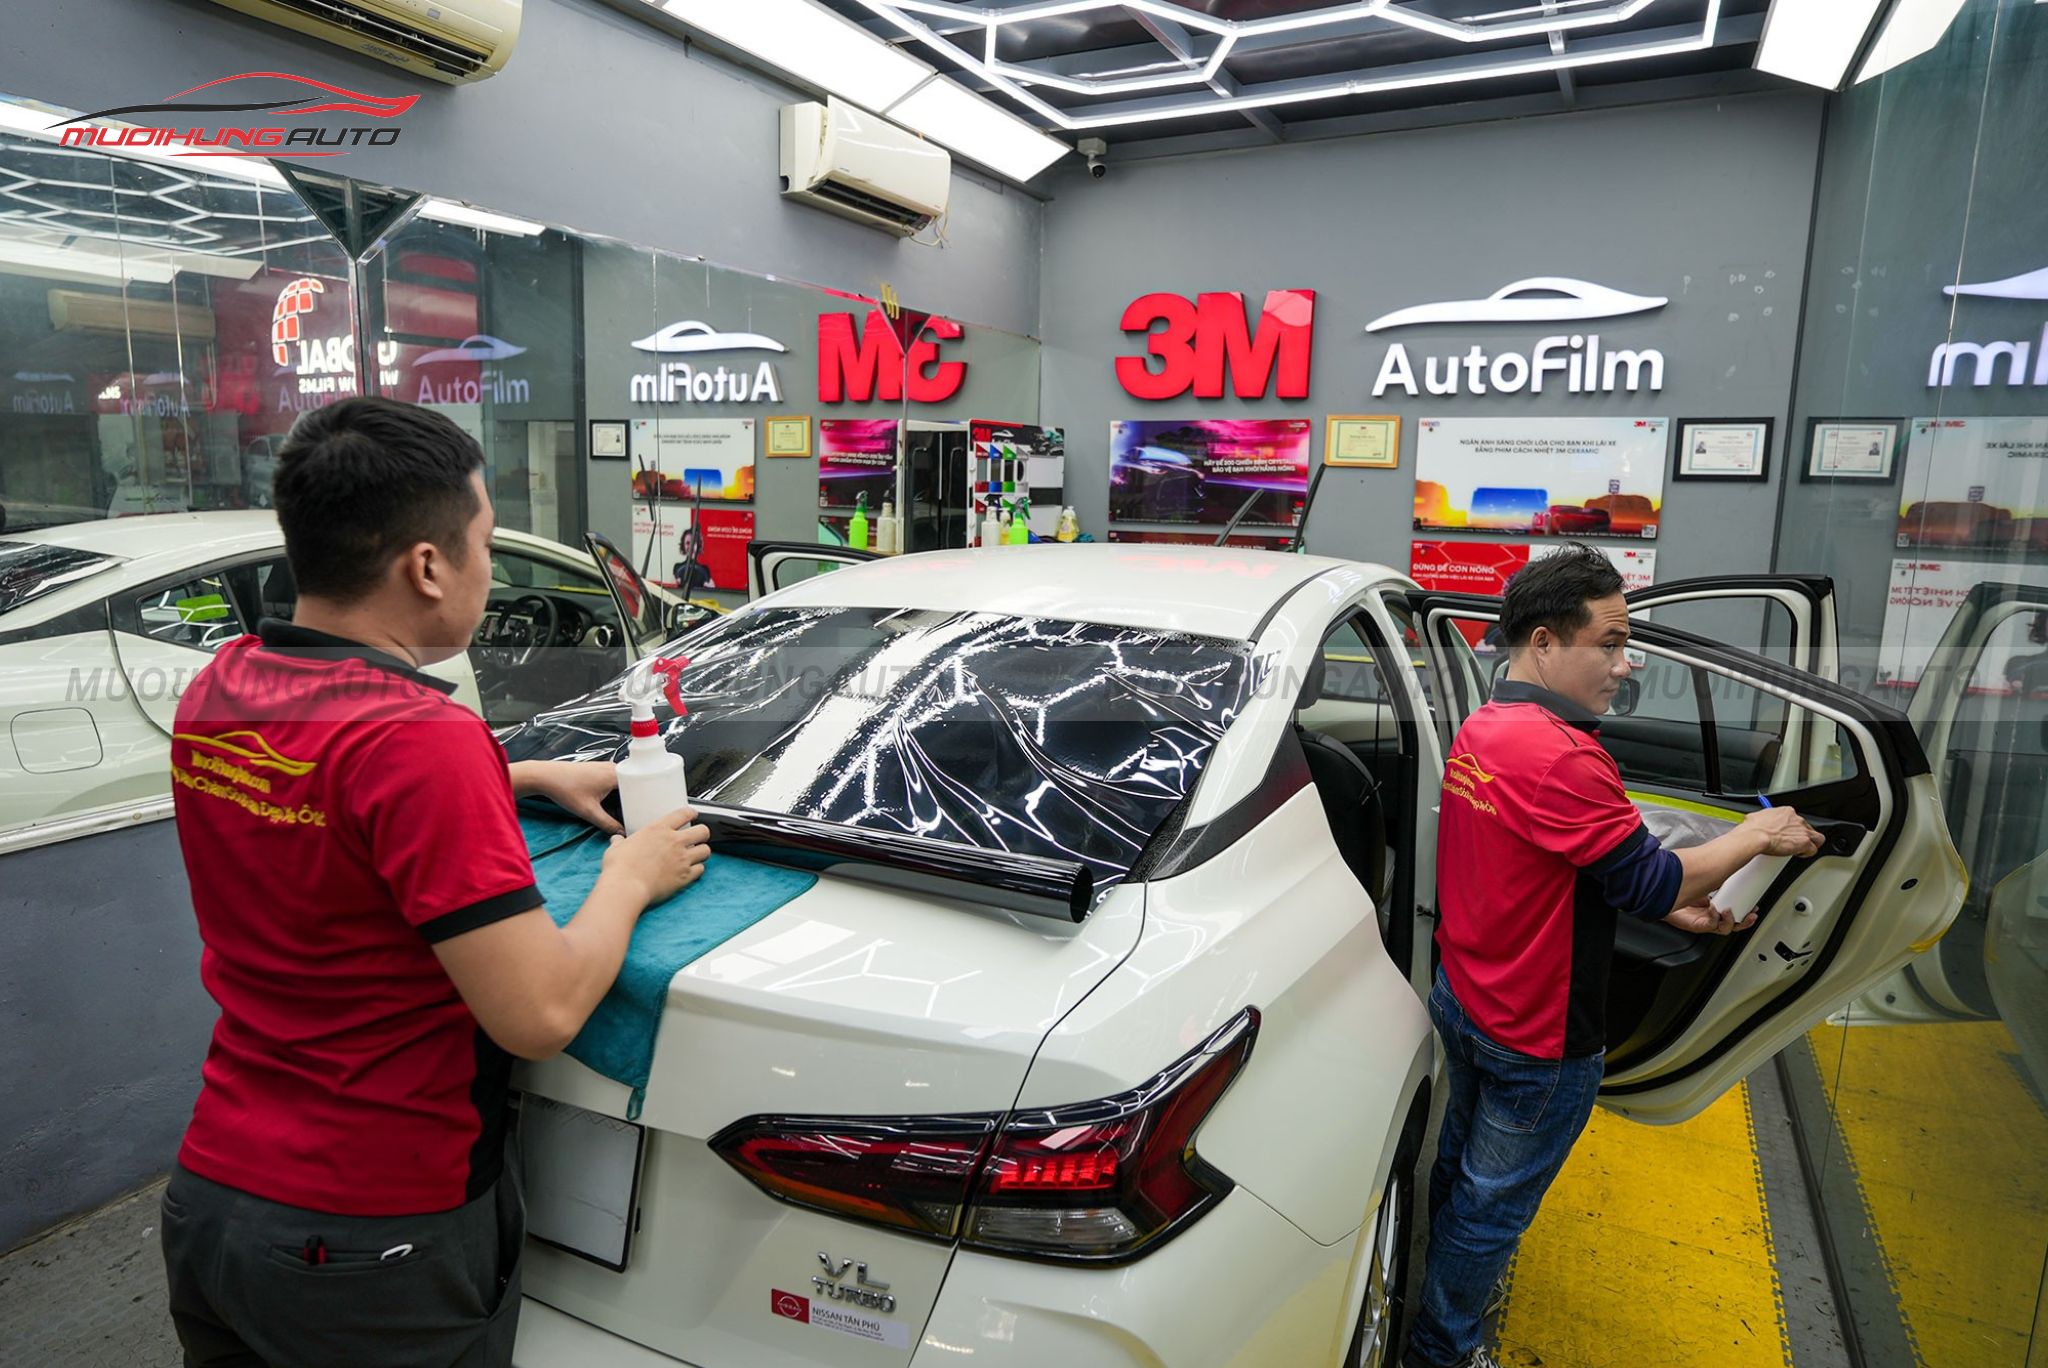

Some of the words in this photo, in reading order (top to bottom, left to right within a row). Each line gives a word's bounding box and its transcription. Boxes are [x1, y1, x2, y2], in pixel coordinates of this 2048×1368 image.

[1114, 289, 1316, 400] 3M
[1371, 334, 1665, 397] AutoFilm
[811, 1275, 897, 1313] TURBO
[812, 1306, 842, 1322] NISSAN
